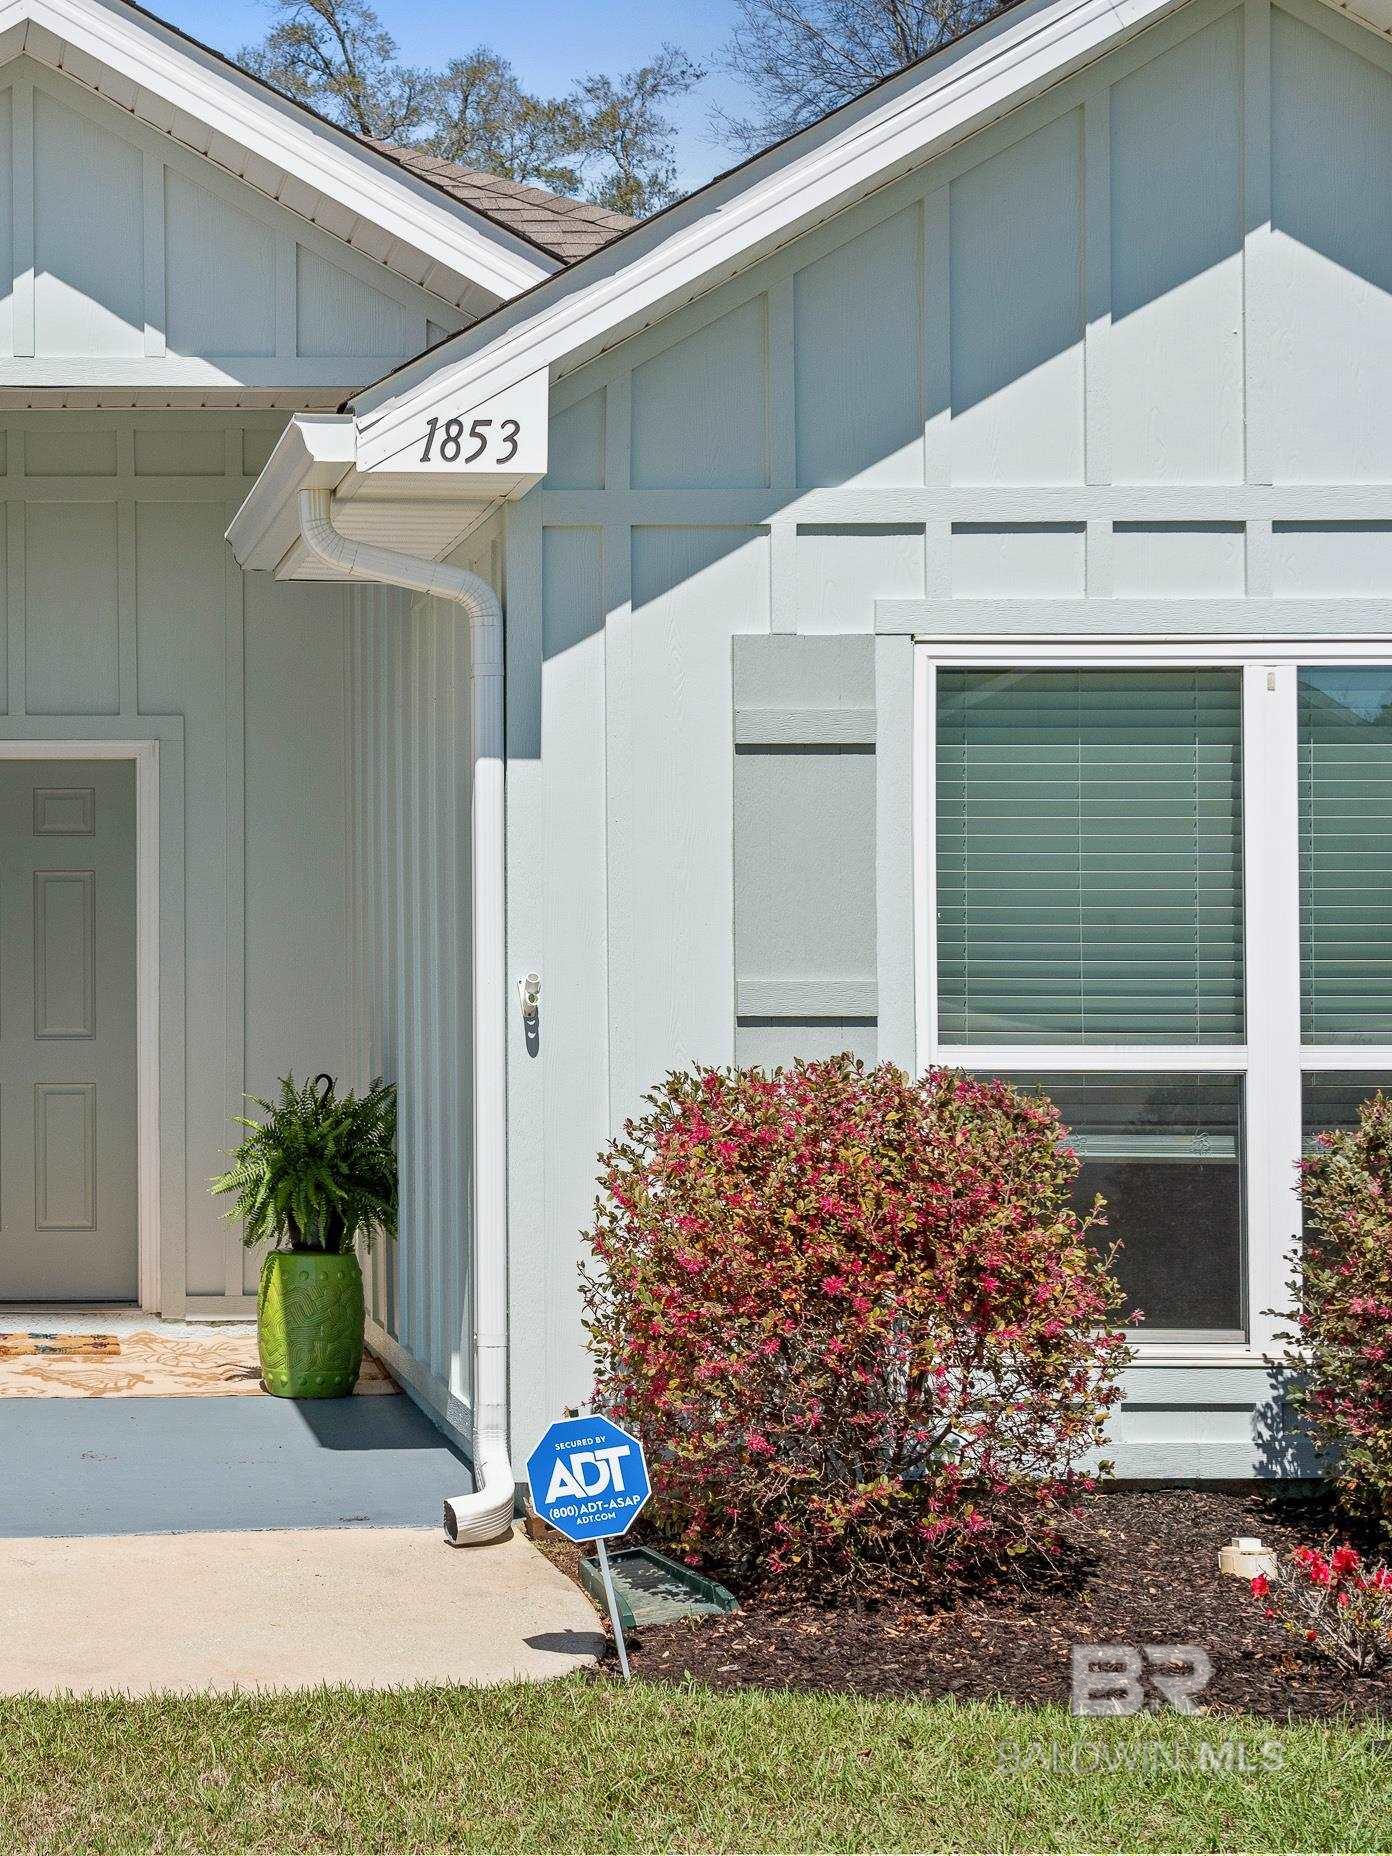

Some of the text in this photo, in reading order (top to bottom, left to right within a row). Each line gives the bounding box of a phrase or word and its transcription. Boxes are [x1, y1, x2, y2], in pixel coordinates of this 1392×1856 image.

[419, 416, 521, 466] 1853
[554, 1435, 606, 1451] SECURED BY
[545, 1445, 631, 1504] ADT
[576, 1511, 616, 1525] ADT.COM
